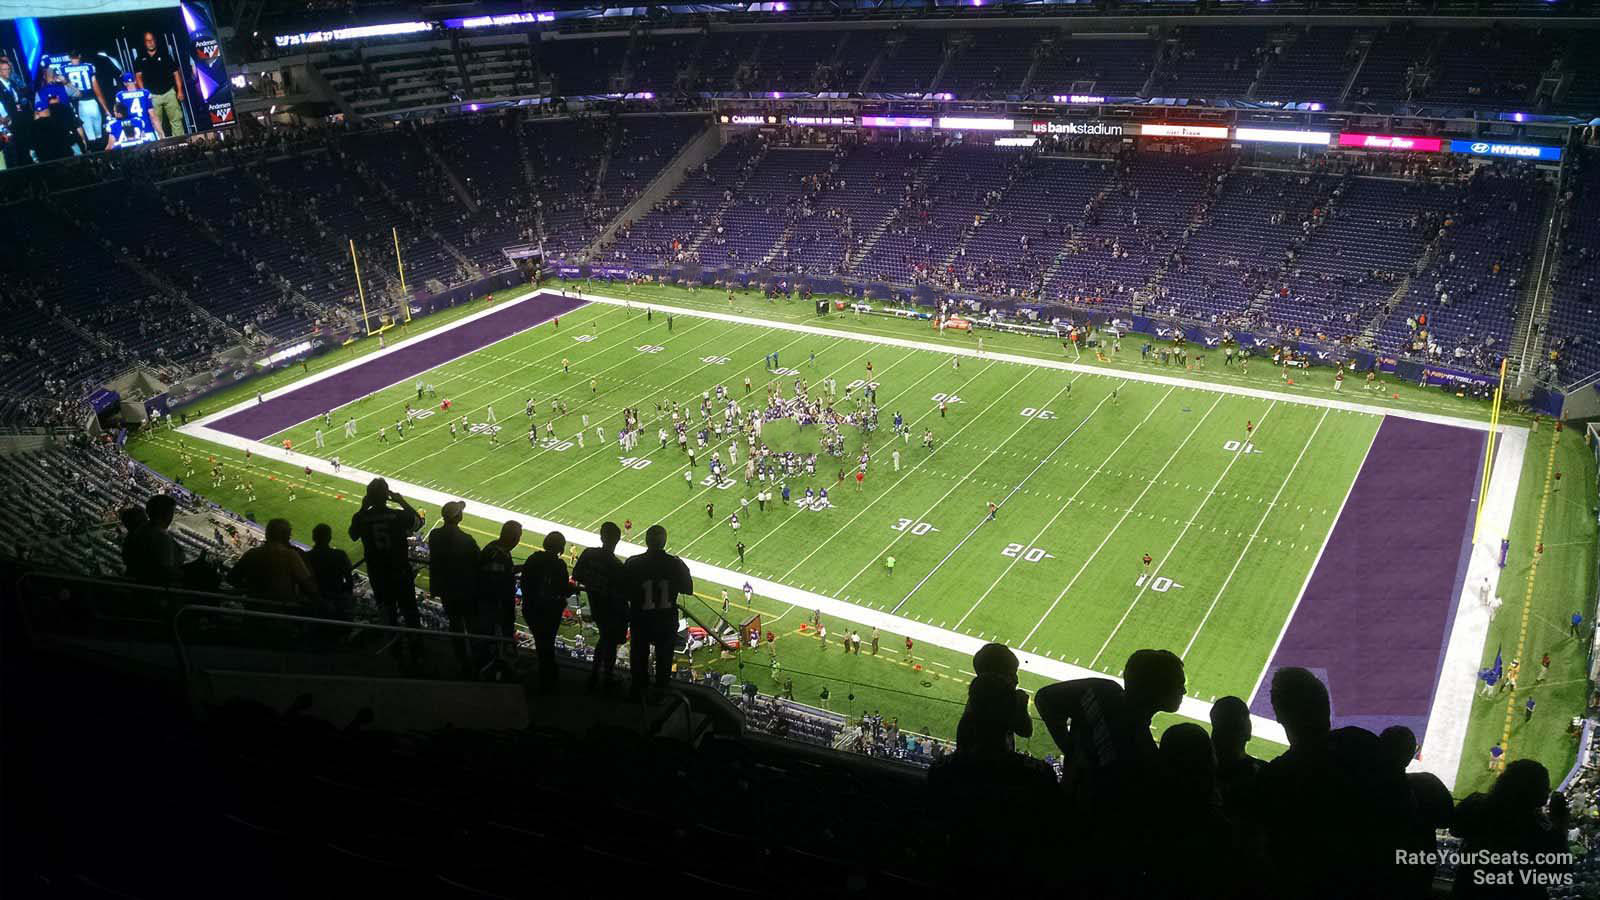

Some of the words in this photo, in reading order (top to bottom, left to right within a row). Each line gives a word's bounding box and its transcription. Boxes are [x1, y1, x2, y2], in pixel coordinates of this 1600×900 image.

[195, 40, 217, 48] Andersen
[130, 98, 144, 117] 4
[208, 102, 231, 111] Andersen
[1491, 145, 1541, 157] HYUNDAI
[617, 455, 652, 470] 40
[890, 517, 933, 536] 30
[1000, 542, 1047, 562] 20
[1135, 574, 1173, 592] 10
[641, 578, 672, 609] 11
